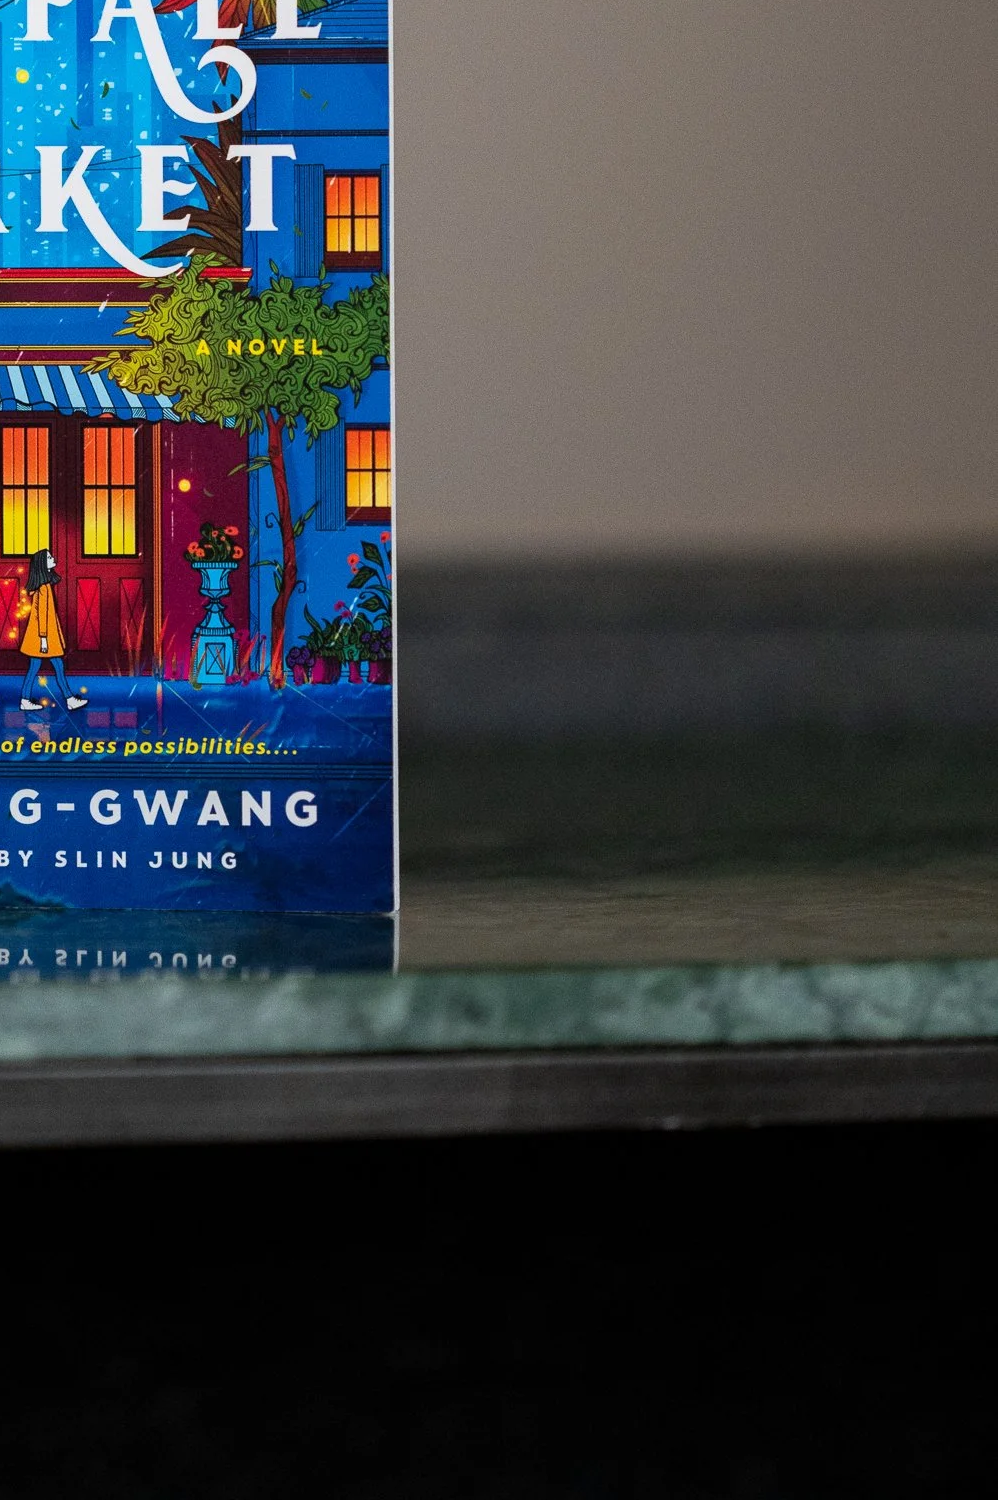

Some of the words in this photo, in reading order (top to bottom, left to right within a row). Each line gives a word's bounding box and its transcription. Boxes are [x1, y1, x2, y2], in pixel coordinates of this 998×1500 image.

[196, 339, 211, 356] A
[227, 338, 323, 356] NOVEL
[1, 737, 25, 753] of
[30, 737, 117, 754] endless
[55, 850, 128, 868] SLIN
[149, 851, 238, 869] JUNG
